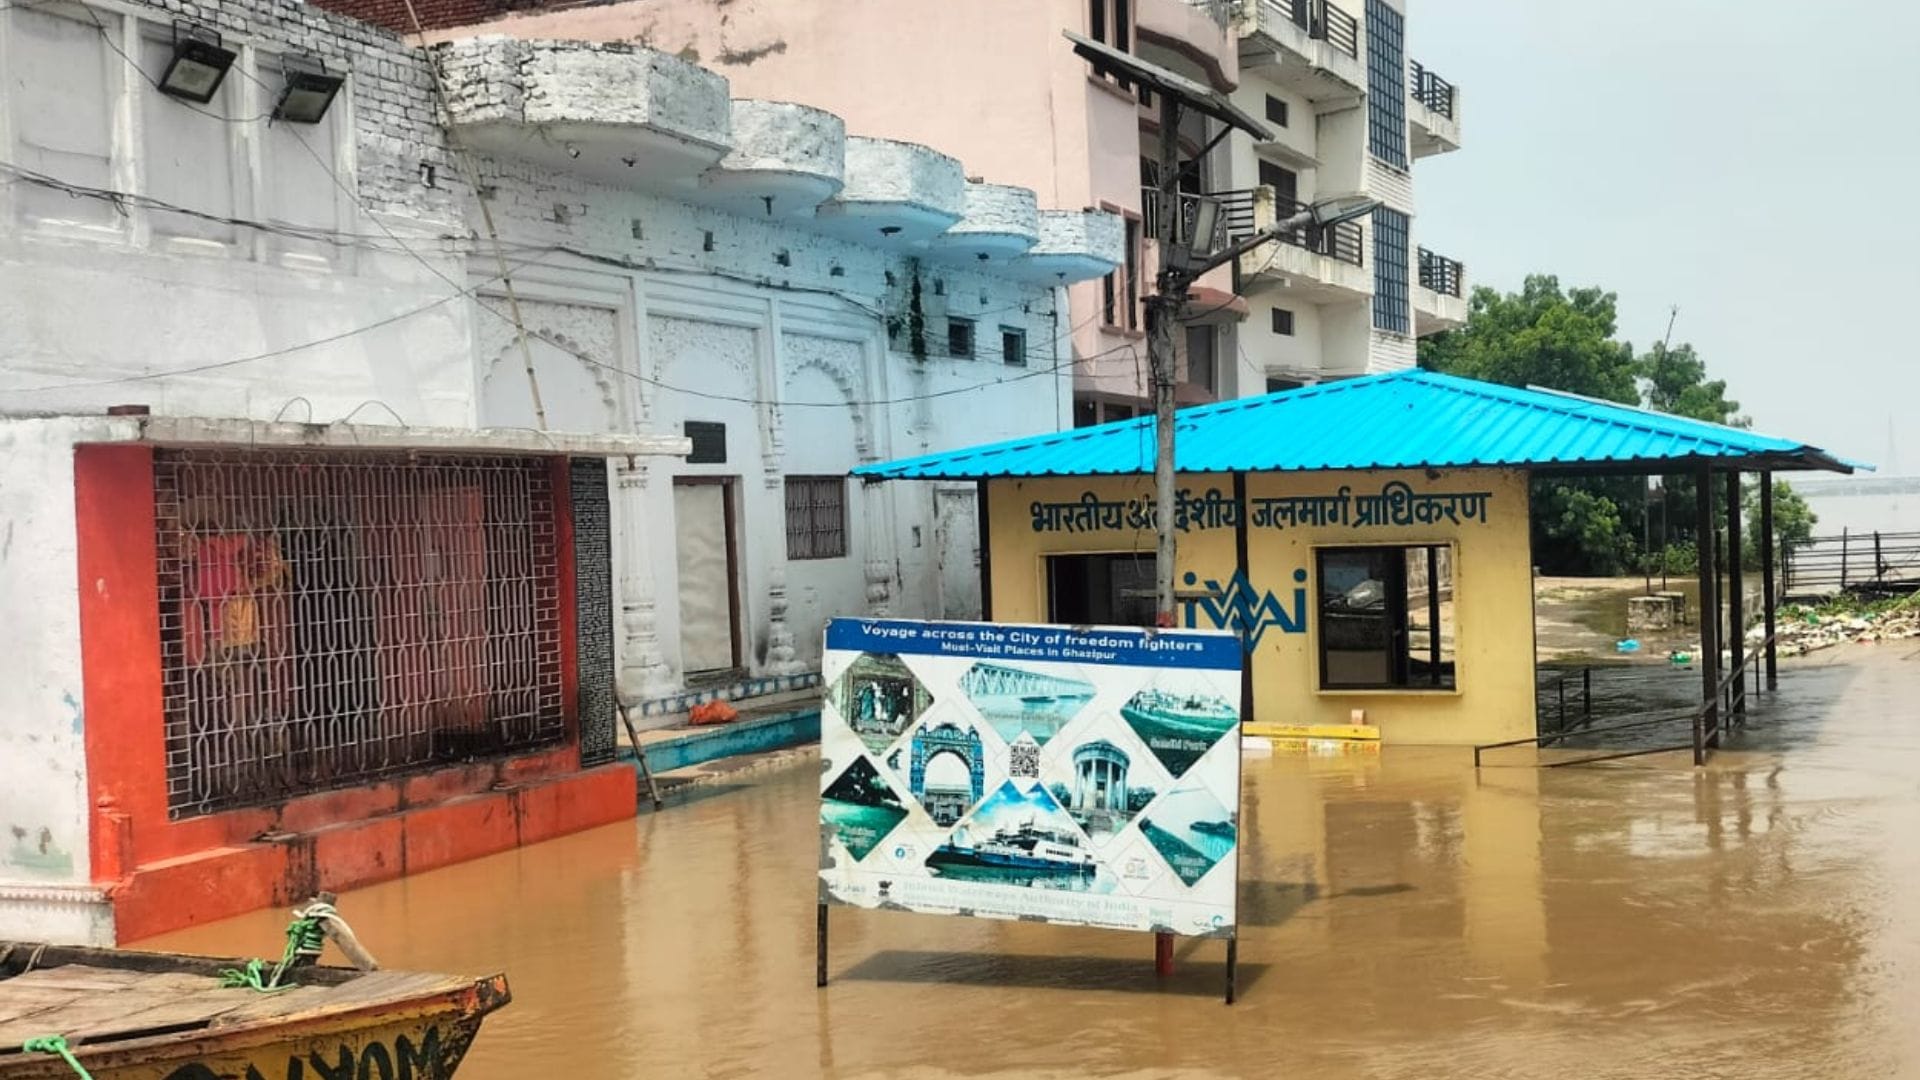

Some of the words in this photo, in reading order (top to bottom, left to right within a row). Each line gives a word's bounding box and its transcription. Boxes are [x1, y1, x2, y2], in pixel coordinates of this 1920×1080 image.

[1031, 491, 1125, 533] भारतीय
[1252, 486, 1351, 530] जलमार्ग
[1352, 481, 1492, 528] प्राधिकरण
[861, 624, 917, 639] Voyage
[922, 630, 975, 641] across
[980, 630, 1004, 642] the
[1009, 632, 1041, 645] City
[1044, 634, 1060, 645] of
[1065, 635, 1134, 648] freedom
[1138, 637, 1203, 652] fighters
[941, 641, 1001, 654] Must-Visit
[1004, 645, 1043, 656] Places
[1047, 647, 1059, 657] in
[1062, 648, 1117, 661] Ghazipur
